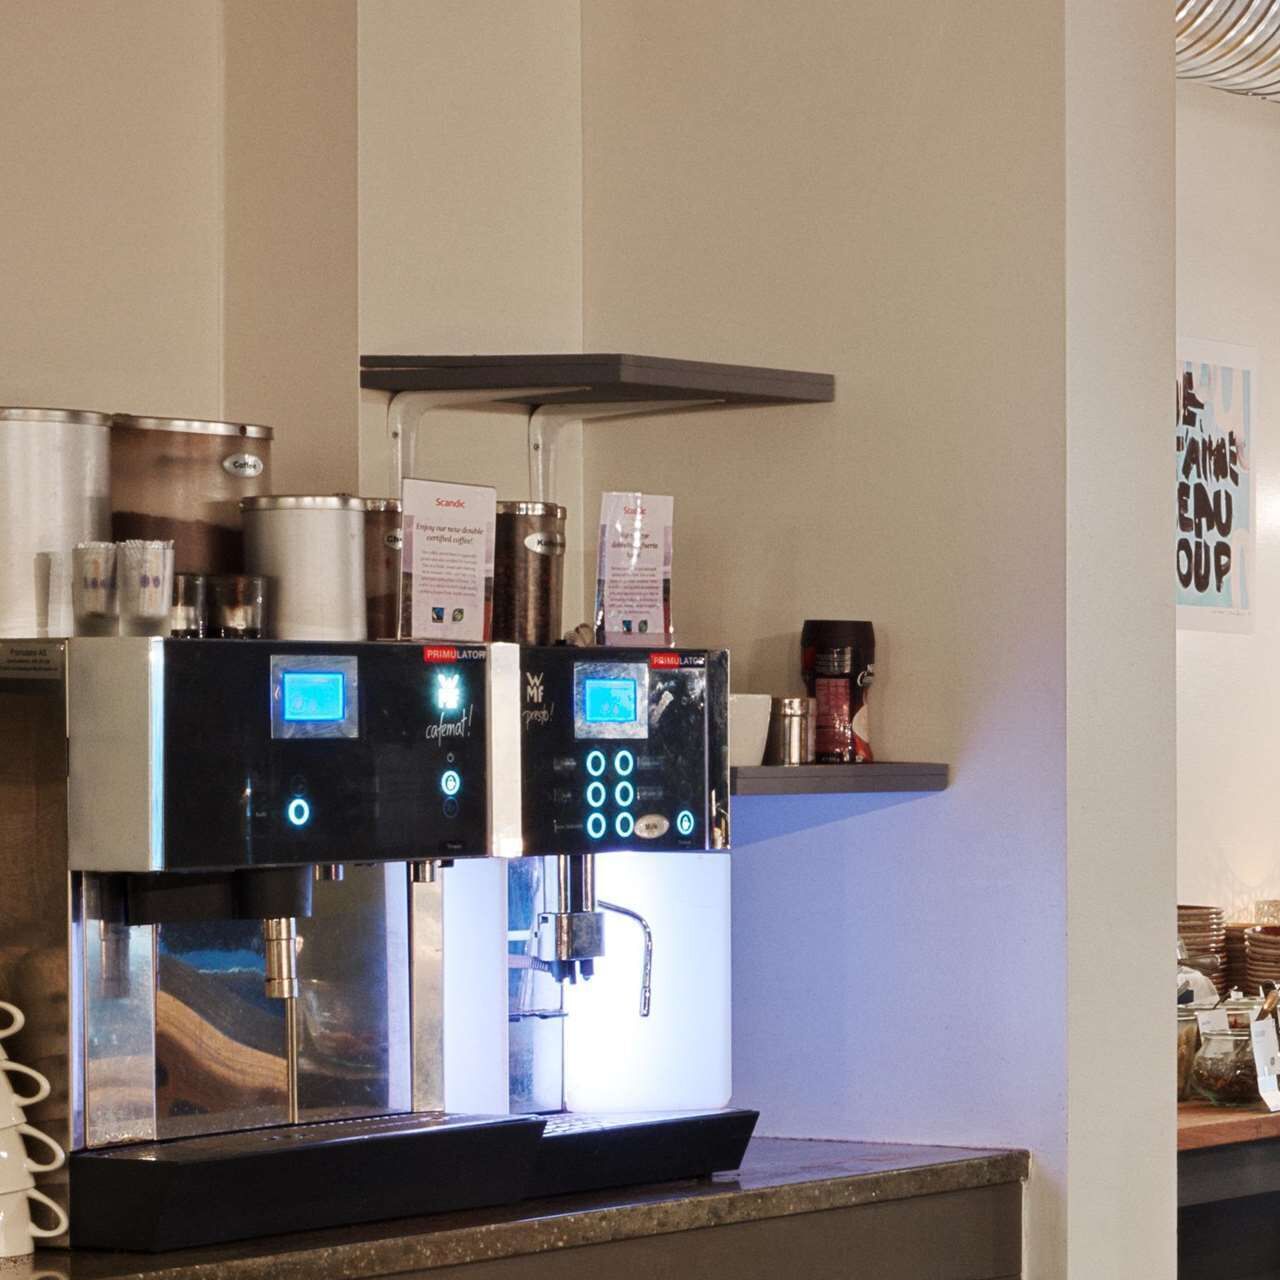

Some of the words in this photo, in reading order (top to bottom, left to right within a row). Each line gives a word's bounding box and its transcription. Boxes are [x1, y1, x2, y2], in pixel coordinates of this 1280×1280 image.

[435, 497, 466, 509] Scandic
[1177, 481, 1233, 538] EAU
[1176, 538, 1232, 593] OUP
[425, 703, 474, 748] cafemat!
